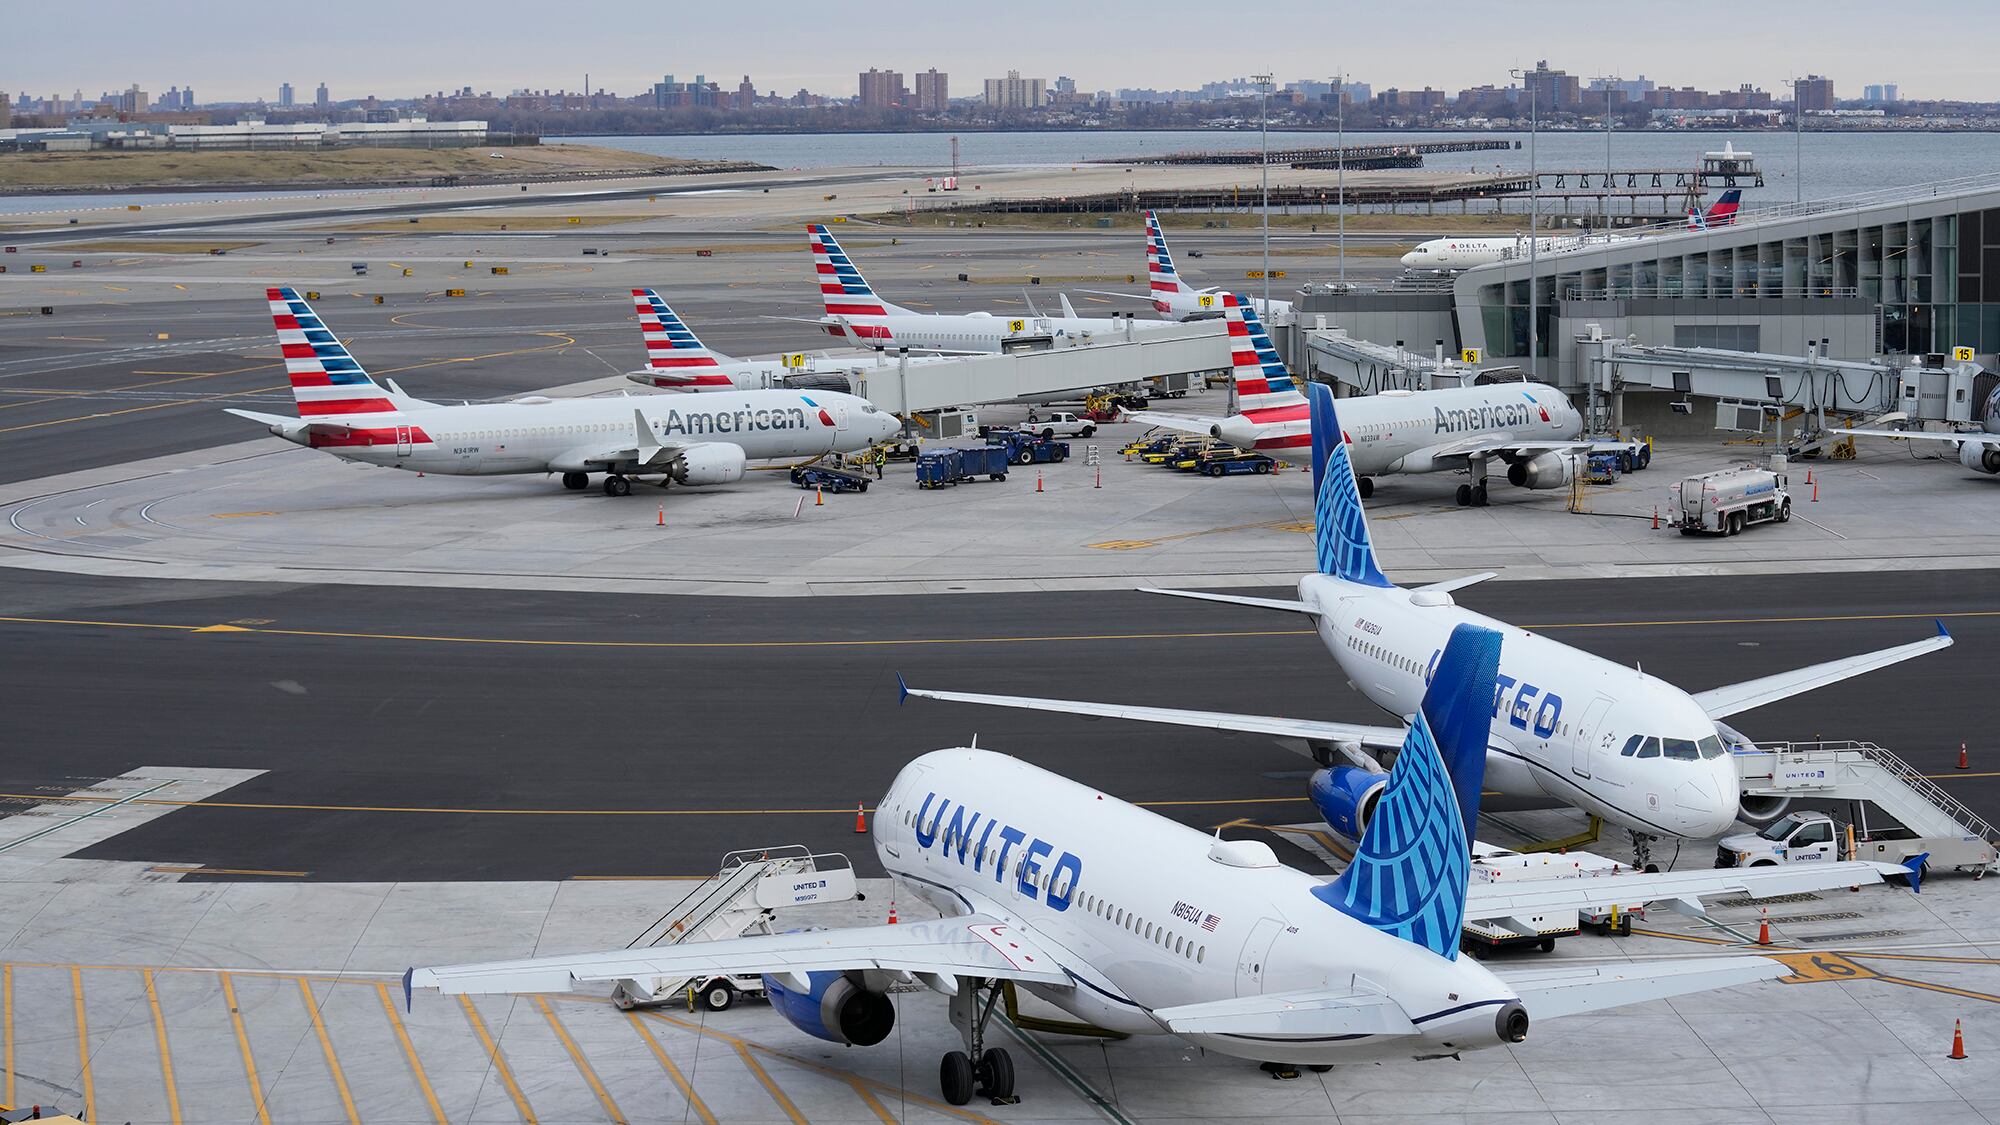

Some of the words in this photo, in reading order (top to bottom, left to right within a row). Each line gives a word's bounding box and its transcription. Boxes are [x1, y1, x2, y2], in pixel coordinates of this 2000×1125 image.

[1202, 296, 1211, 306] 19
[1012, 321, 1022, 331] 18
[1465, 350, 1475, 362] 16
[1959, 349, 1970, 360] 15
[793, 355, 801, 366] 17
[664, 403, 805, 436] American
[1434, 399, 1530, 434] American
[916, 791, 1082, 912] UNITED
[793, 882, 818, 891] UNITED
[1170, 900, 1203, 925] N815UA
